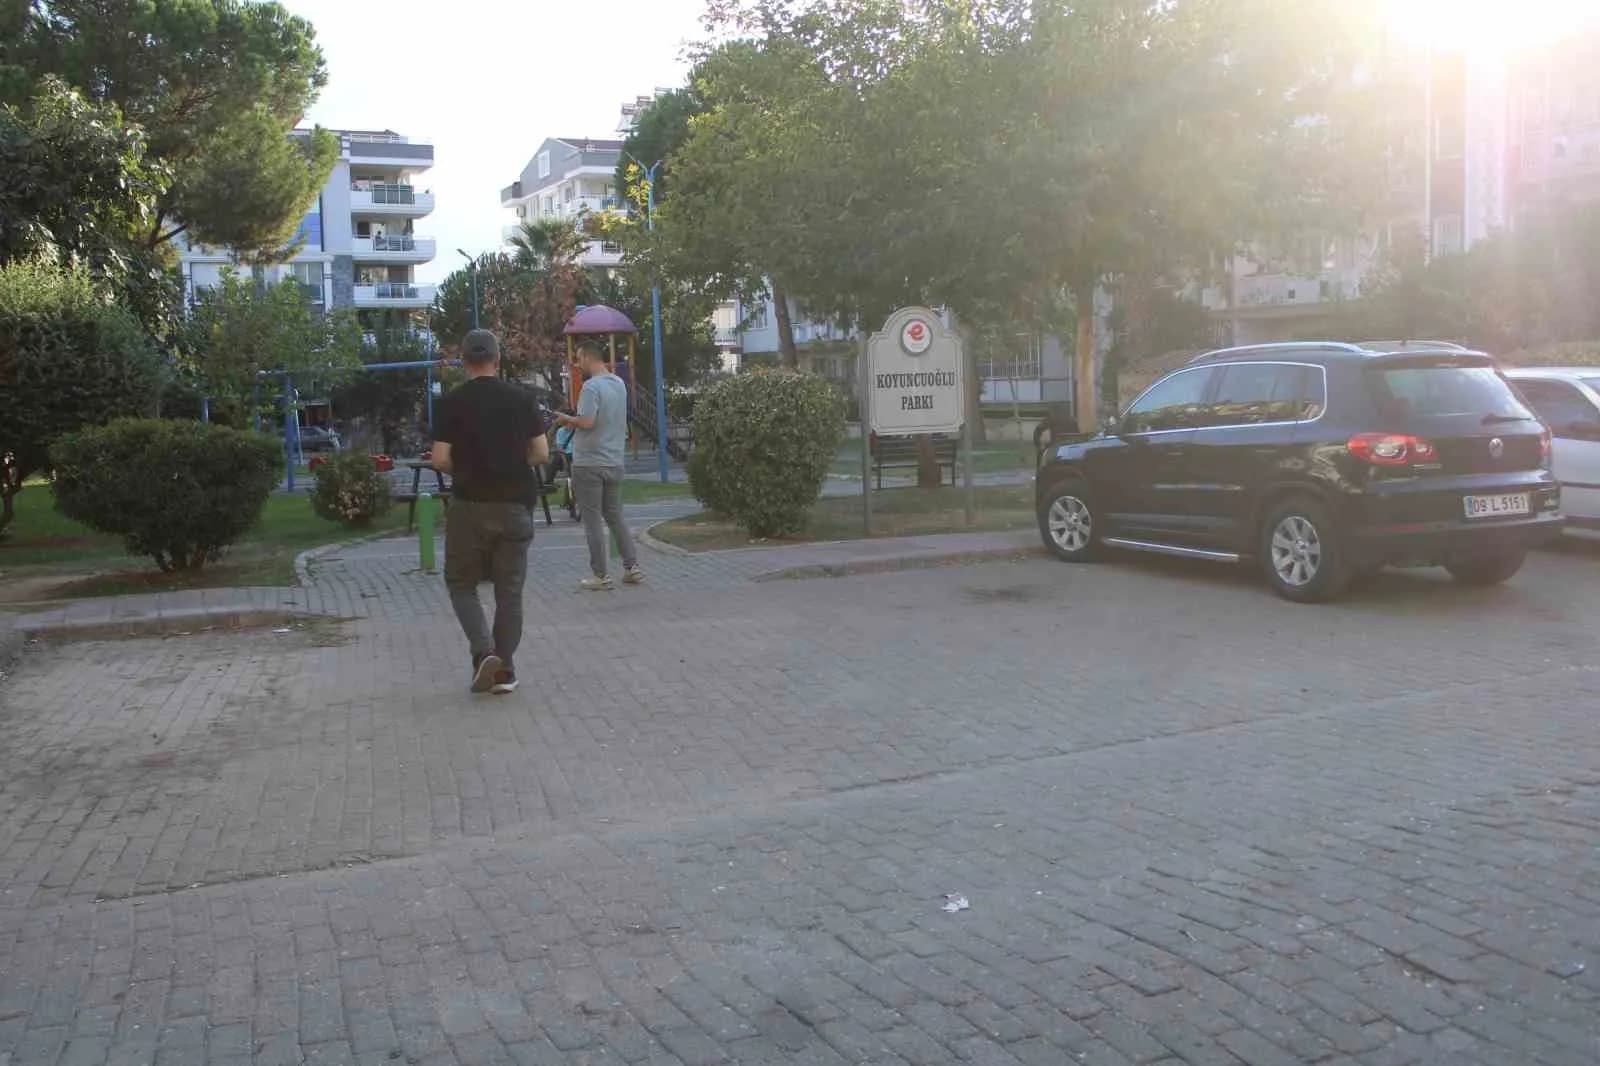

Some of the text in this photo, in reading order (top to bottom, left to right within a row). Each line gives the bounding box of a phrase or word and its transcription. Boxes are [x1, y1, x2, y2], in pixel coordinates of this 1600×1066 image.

[876, 370, 955, 389] KOYUNCUOĞLU
[901, 395, 934, 410] PARKI
[1491, 498, 1500, 512] L
